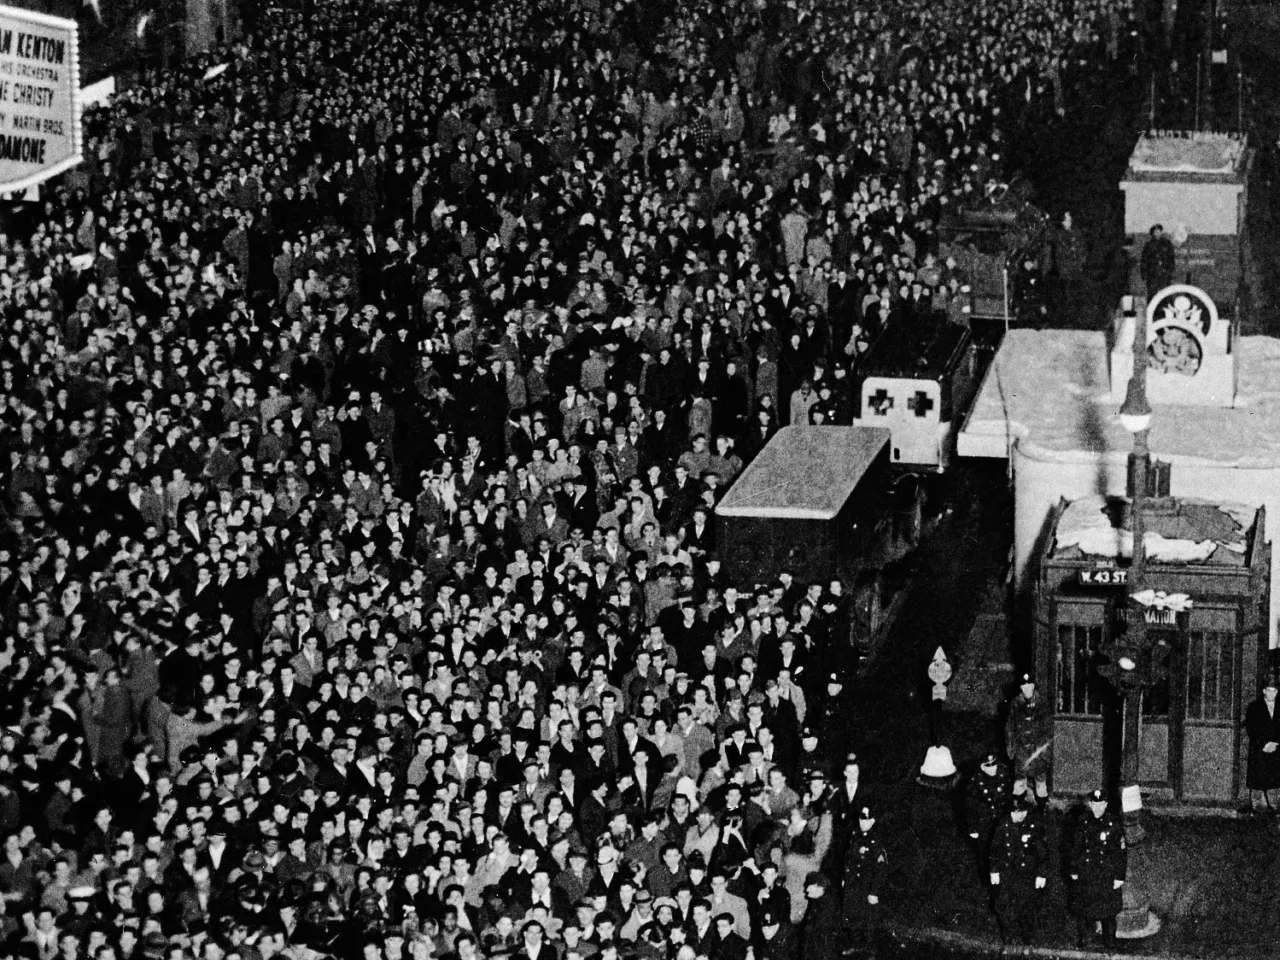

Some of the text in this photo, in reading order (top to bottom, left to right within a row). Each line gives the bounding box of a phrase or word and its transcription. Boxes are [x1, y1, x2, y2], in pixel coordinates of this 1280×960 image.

[16, 31, 65, 65] KENTON
[16, 64, 59, 83] ORCHESTRA
[13, 83, 55, 108] CHRISTY
[13, 114, 41, 132] MARTIN
[43, 119, 65, 136] BROS.
[1081, 571, 1128, 584] W. 43 ST.
